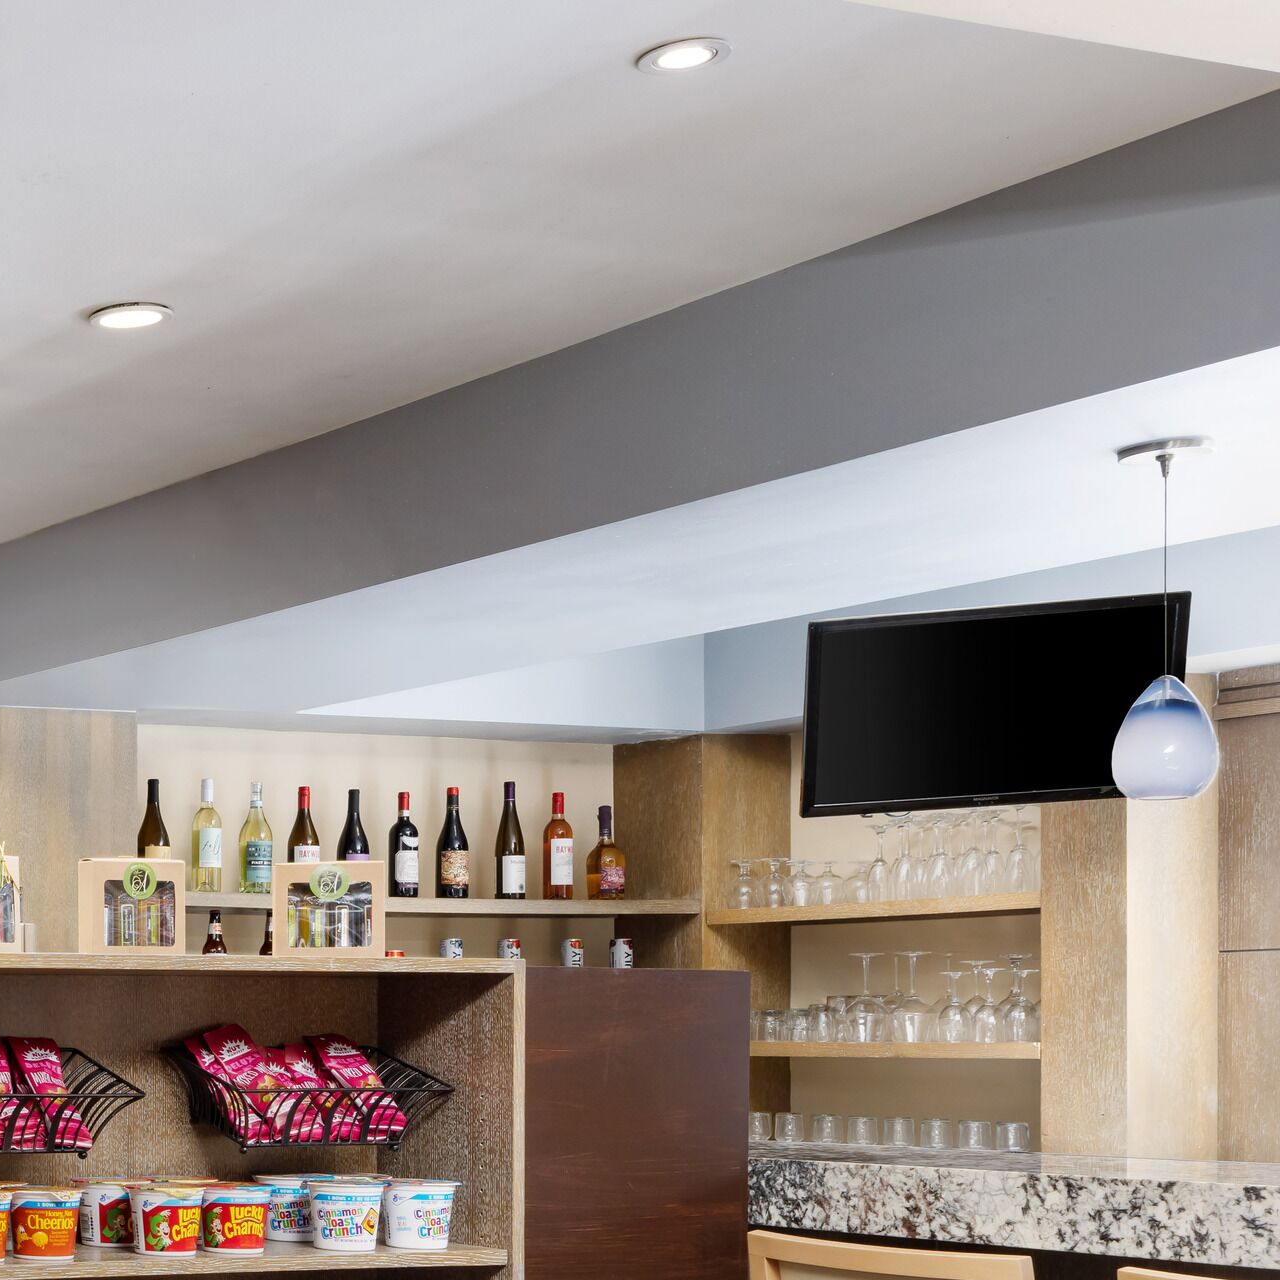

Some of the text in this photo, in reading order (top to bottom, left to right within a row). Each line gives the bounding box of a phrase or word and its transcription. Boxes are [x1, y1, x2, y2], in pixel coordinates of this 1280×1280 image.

[230, 1205, 264, 1223] Lucky
[318, 1207, 363, 1220] Cinnamon
[27, 1214, 74, 1230] Cheerios
[224, 1219, 264, 1239] Charms
[326, 1216, 356, 1227] Toast
[321, 1224, 363, 1238] Crunch
